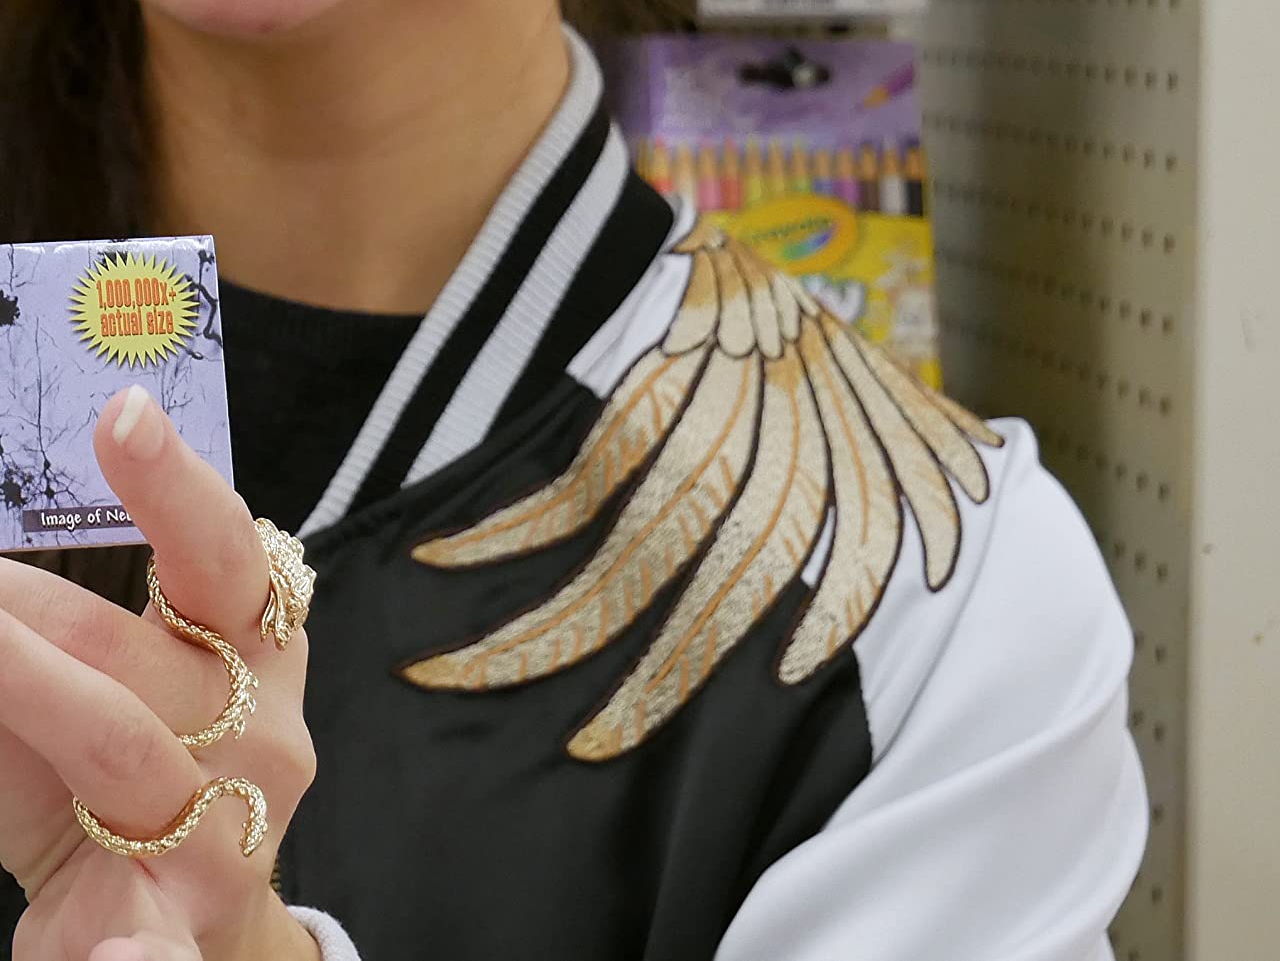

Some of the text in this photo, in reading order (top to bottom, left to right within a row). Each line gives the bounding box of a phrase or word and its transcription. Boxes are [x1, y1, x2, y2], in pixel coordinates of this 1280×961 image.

[100, 306, 174, 337] actual size
[40, 511, 82, 531] Image
[87, 508, 102, 525] of
